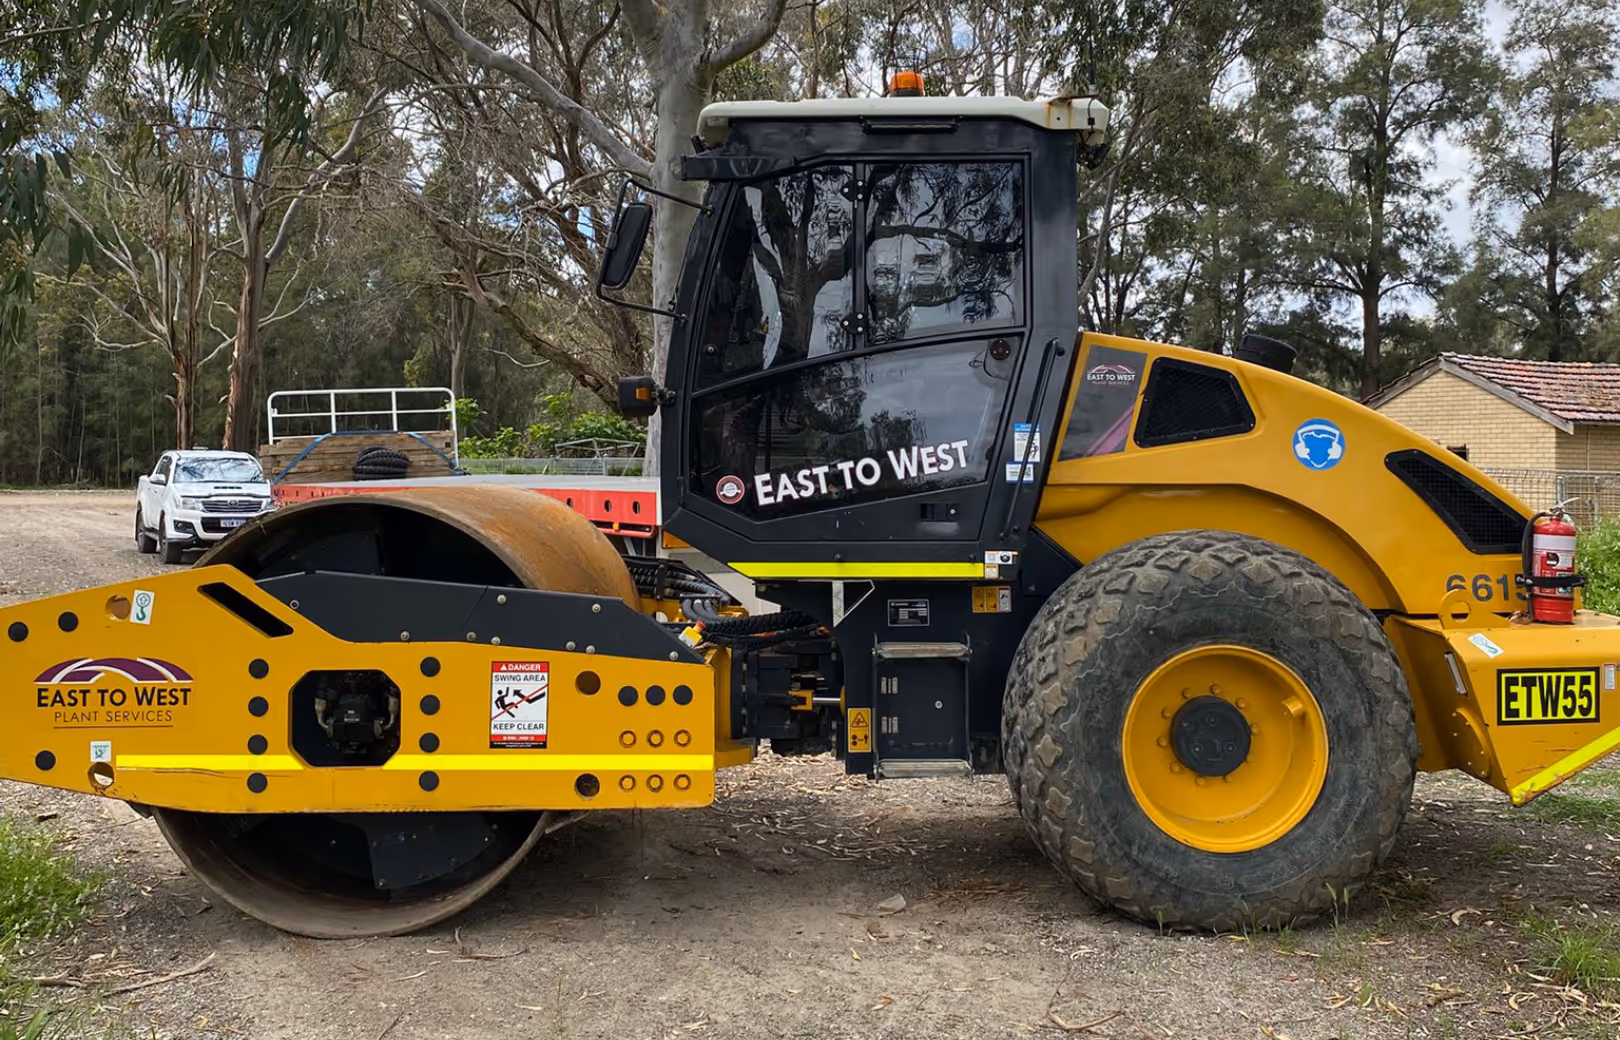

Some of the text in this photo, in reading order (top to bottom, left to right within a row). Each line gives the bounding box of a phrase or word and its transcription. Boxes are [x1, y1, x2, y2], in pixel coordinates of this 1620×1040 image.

[753, 465, 829, 506] EAST
[837, 457, 881, 490] TO
[887, 440, 968, 481] WEST
[494, 674, 546, 682] SWING AREA
[37, 686, 191, 707] EAST TO WEST
[1504, 675, 1593, 719] ETW55
[54, 710, 173, 723] PLANT SERVICES
